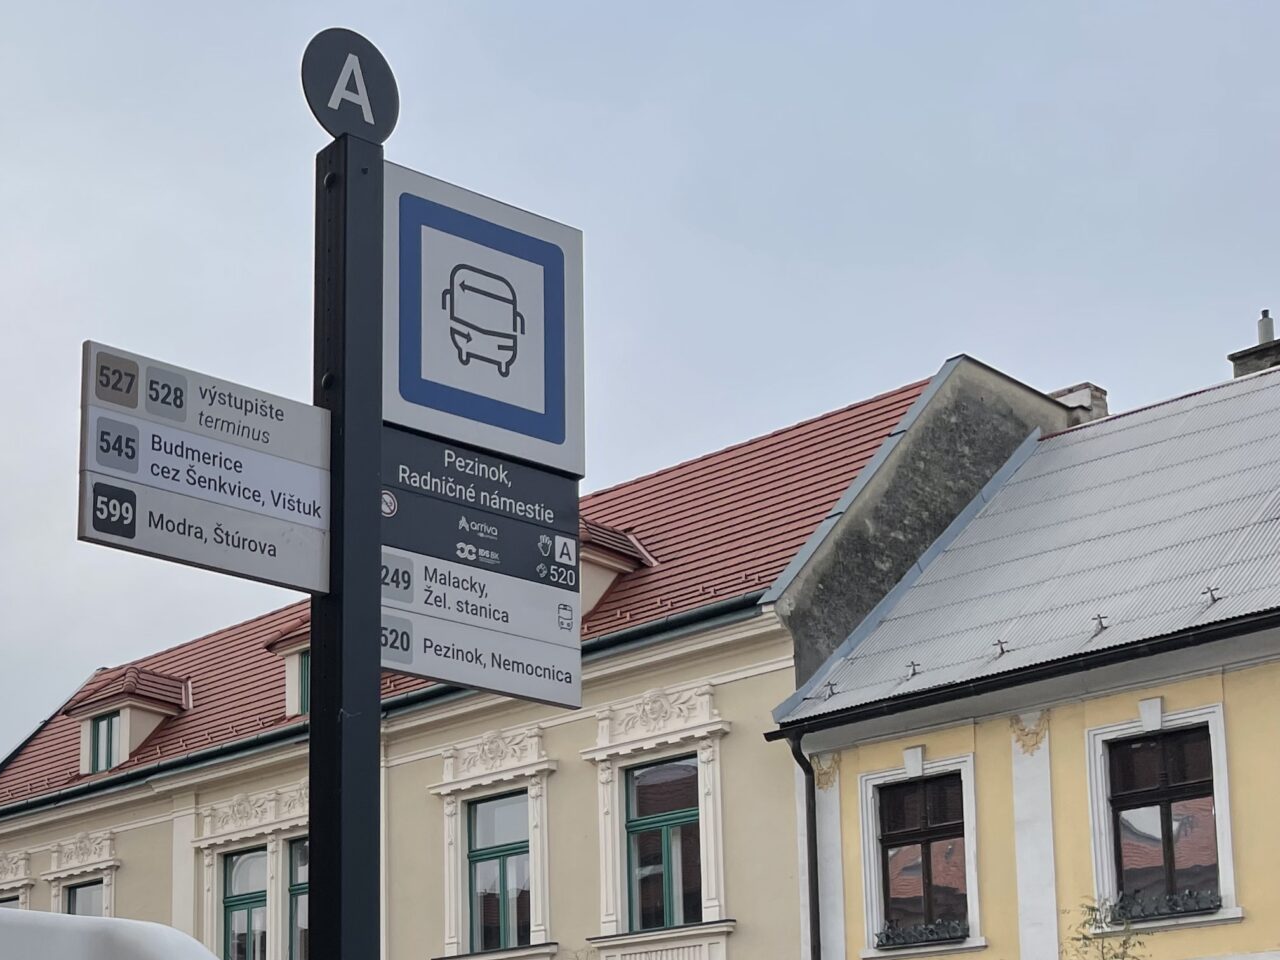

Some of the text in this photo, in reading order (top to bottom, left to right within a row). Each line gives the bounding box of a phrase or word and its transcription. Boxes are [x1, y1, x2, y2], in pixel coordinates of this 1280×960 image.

[327, 53, 375, 125] A
[99, 364, 184, 409] 527 528
[199, 386, 285, 422] výstupište
[99, 430, 136, 460] 545
[198, 411, 270, 444] terminus
[151, 434, 243, 473] Budmerice
[444, 450, 513, 488] Pezinok,
[150, 462, 322, 519] cez Šenkvice, Vištuk
[398, 465, 555, 524] Radničné námestie
[96, 496, 134, 525] 599
[148, 511, 277, 558] Modra, Štúrova
[559, 541, 573, 561] A
[381, 565, 411, 591] 249
[424, 565, 489, 598] Malacky,
[550, 565, 576, 586] 520
[424, 585, 510, 624] Žel. stanica
[423, 638, 573, 684] Pezinok, Nemocnica
